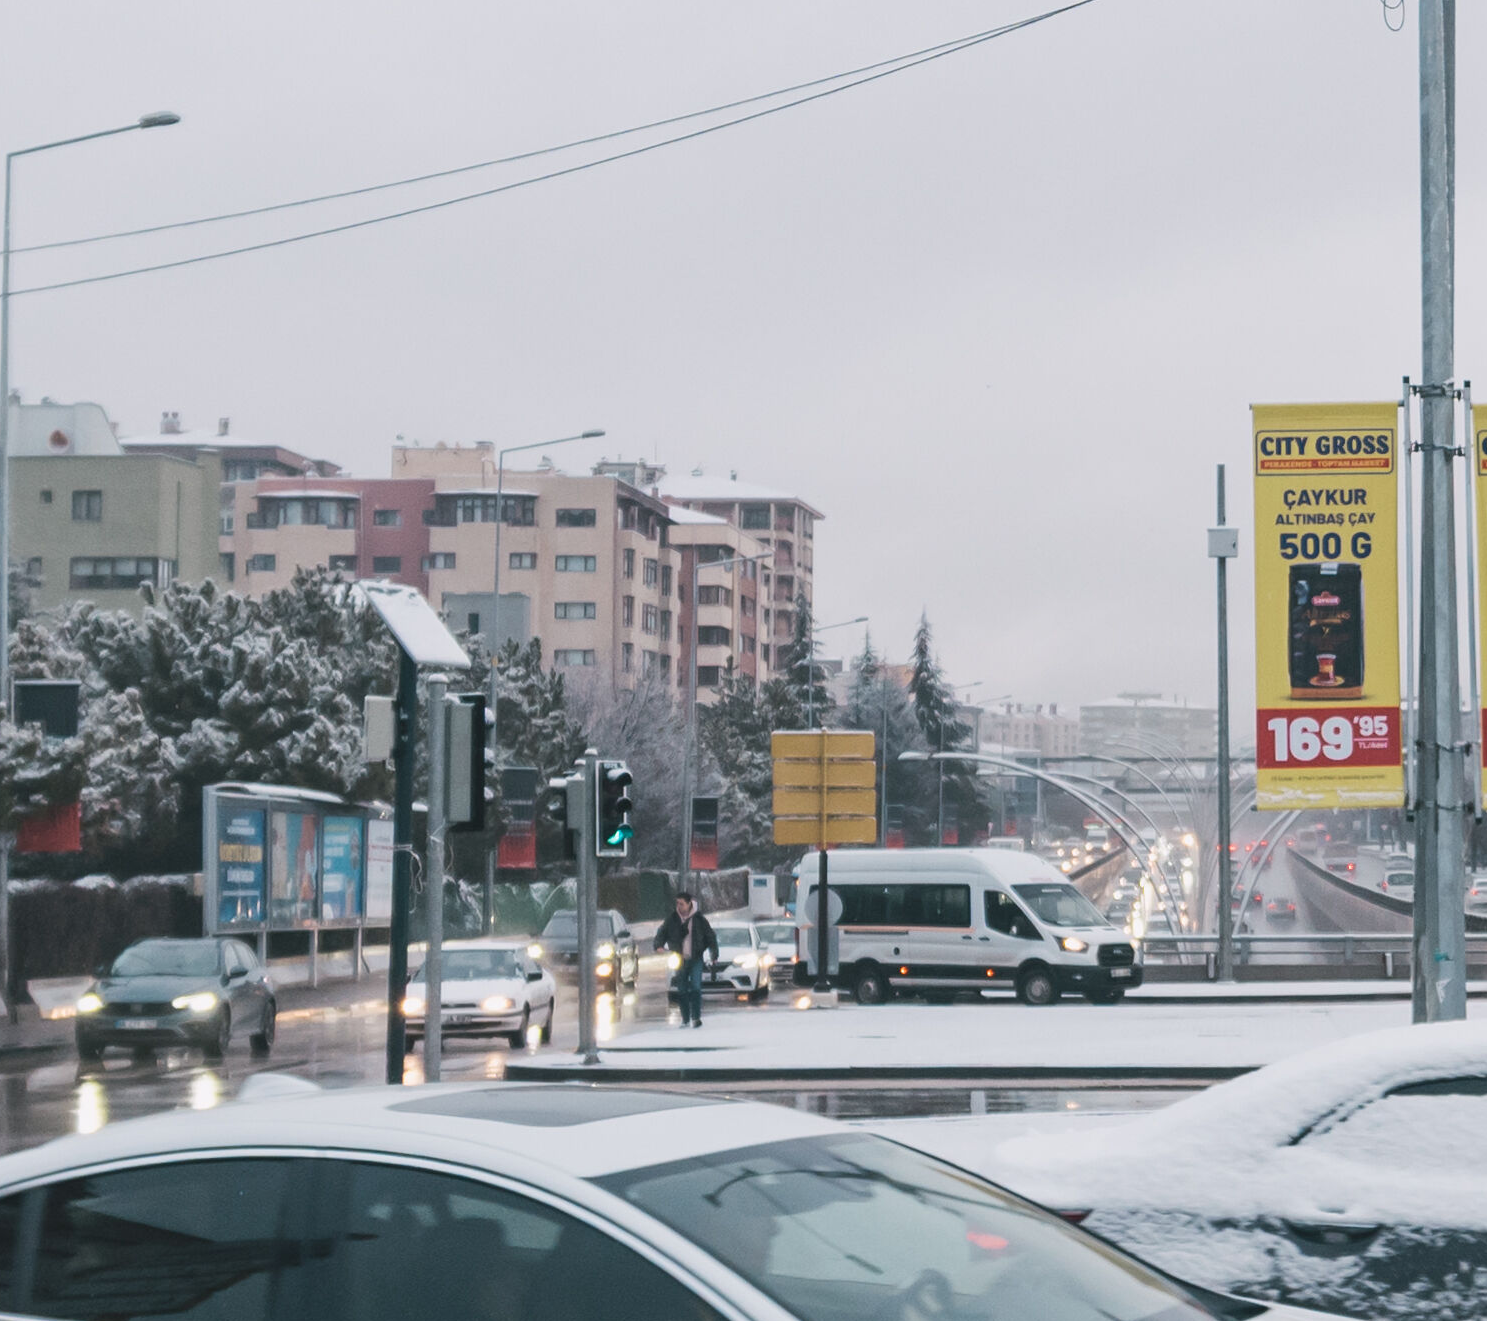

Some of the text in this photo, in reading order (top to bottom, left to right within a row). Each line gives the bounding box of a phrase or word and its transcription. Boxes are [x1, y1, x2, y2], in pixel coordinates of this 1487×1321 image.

[1260, 435, 1390, 456] CITY GROSS
[1283, 488, 1367, 510] ÇAYKUR
[1275, 512, 1376, 527] ALTINBAŞ ÇAY
[1279, 531, 1372, 560] 500 G
